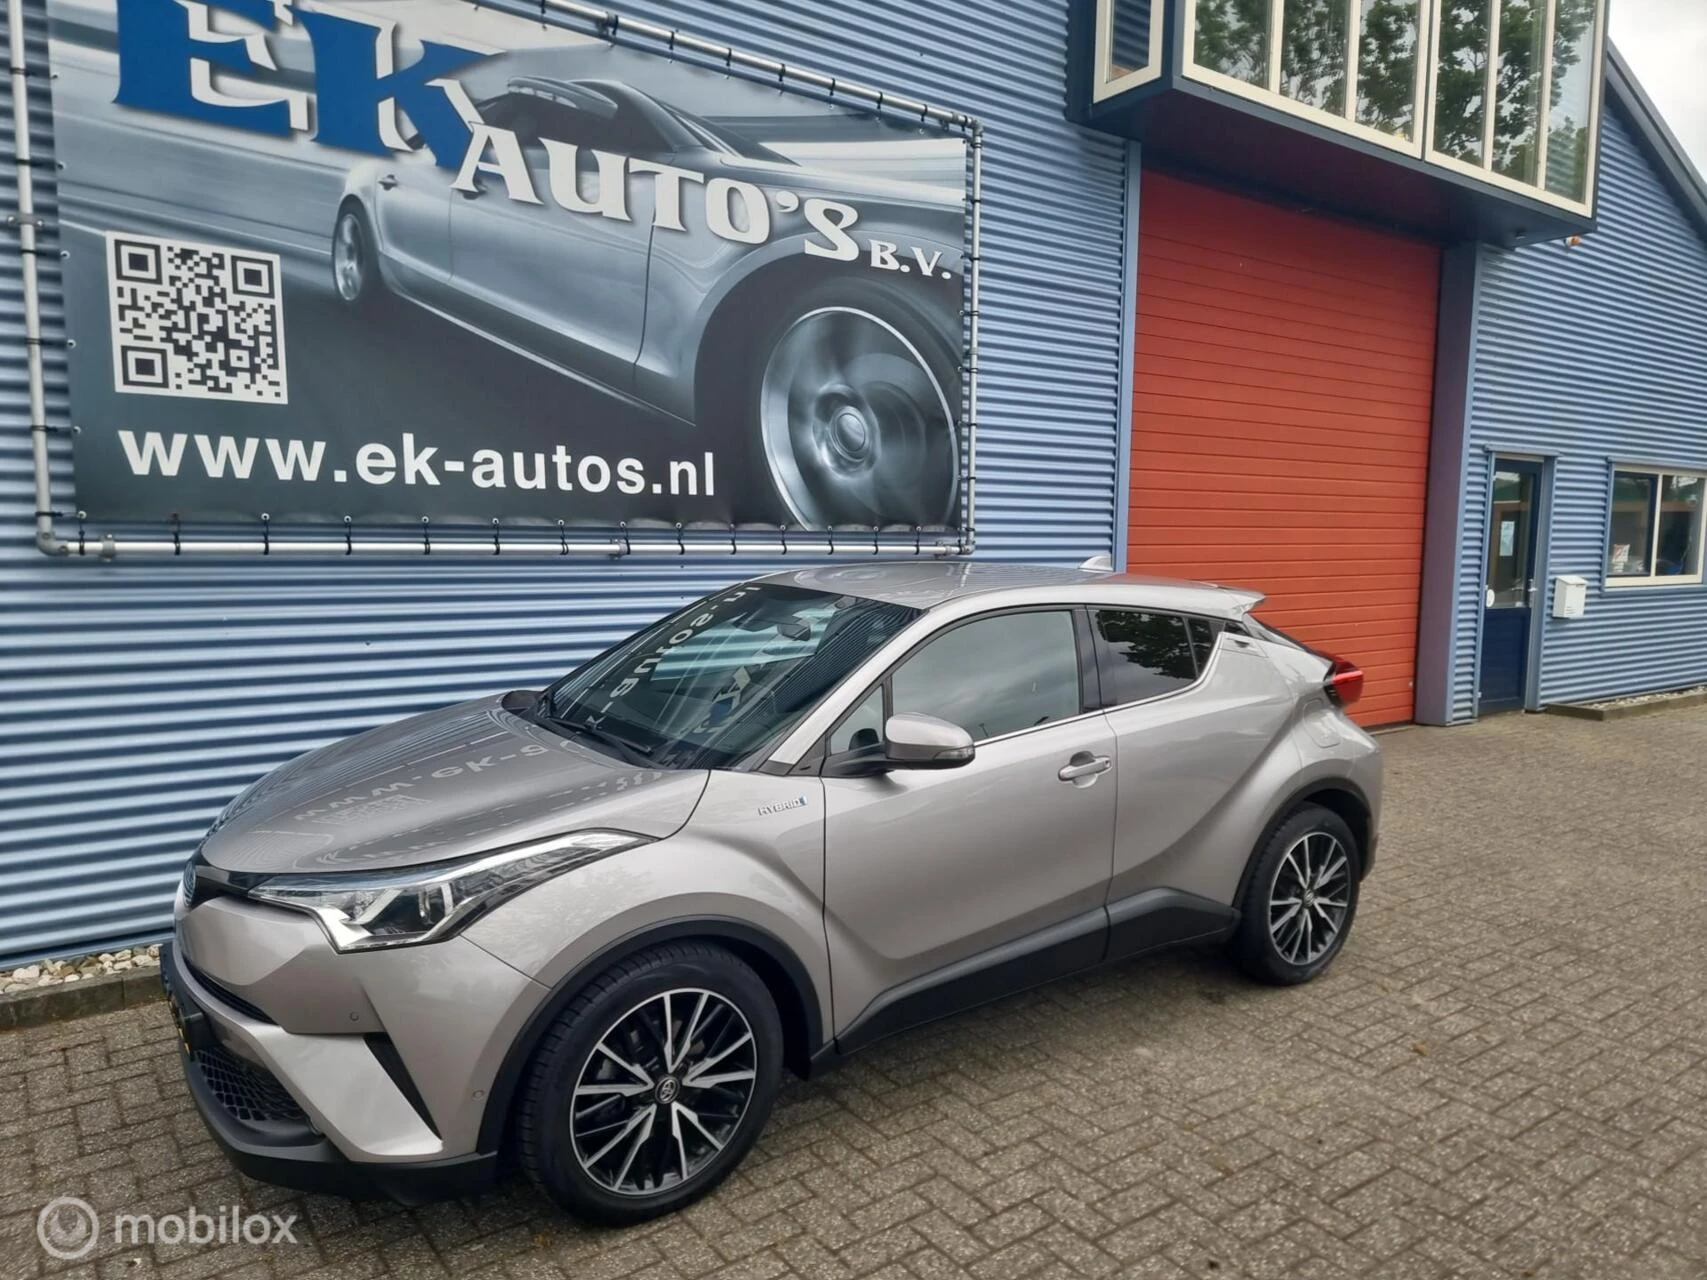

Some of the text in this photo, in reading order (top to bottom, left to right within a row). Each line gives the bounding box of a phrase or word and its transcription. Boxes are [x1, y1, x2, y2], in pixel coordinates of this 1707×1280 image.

[112, 0, 508, 182] EK
[869, 238, 953, 281] B.V.
[118, 430, 715, 497] www.ek-autos.nl
[757, 797, 801, 816] HYBRID
